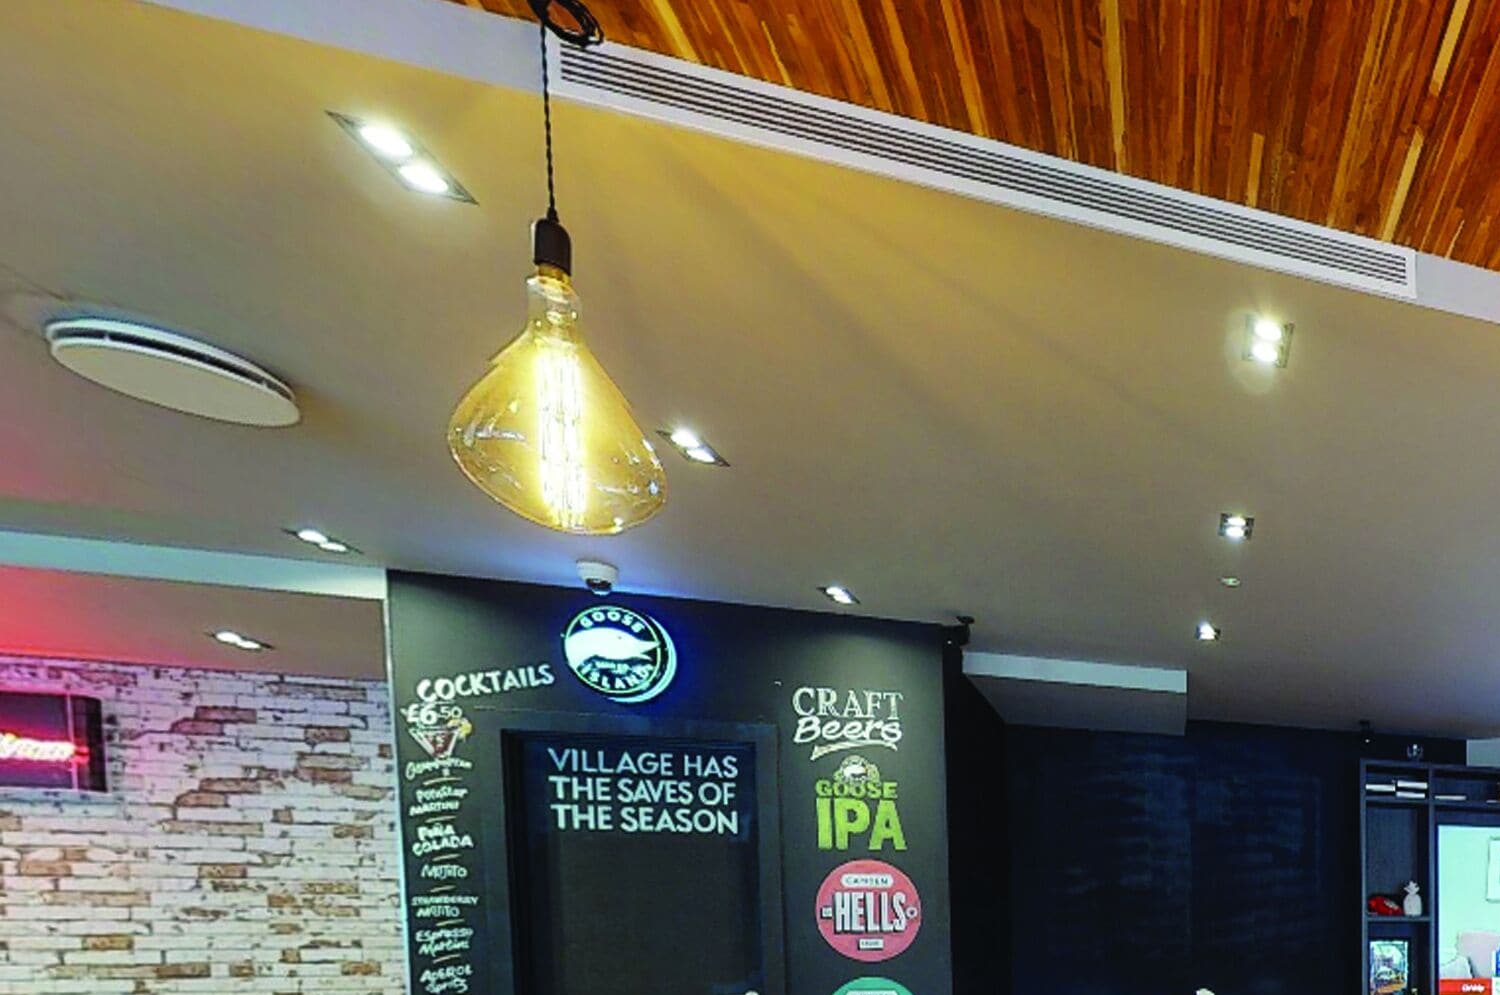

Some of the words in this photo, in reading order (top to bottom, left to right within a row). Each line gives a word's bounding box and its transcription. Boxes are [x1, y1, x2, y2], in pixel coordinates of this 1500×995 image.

[580, 611, 645, 633] GOOSE
[416, 664, 555, 702] COCKTAILS
[580, 663, 653, 689] ISLAND
[792, 686, 904, 720] CRAFT
[793, 716, 903, 743] Beers
[548, 748, 673, 776] VILLAGE
[684, 755, 739, 779] HAS
[548, 776, 612, 801] THE
[617, 777, 694, 805] SAVES
[698, 782, 737, 806] OF
[815, 780, 898, 799] GOOSE
[550, 804, 613, 830] THE
[620, 806, 739, 834] SEASON
[815, 798, 908, 850] IPA
[412, 834, 474, 856] COLADA
[834, 891, 906, 932] HELLS
